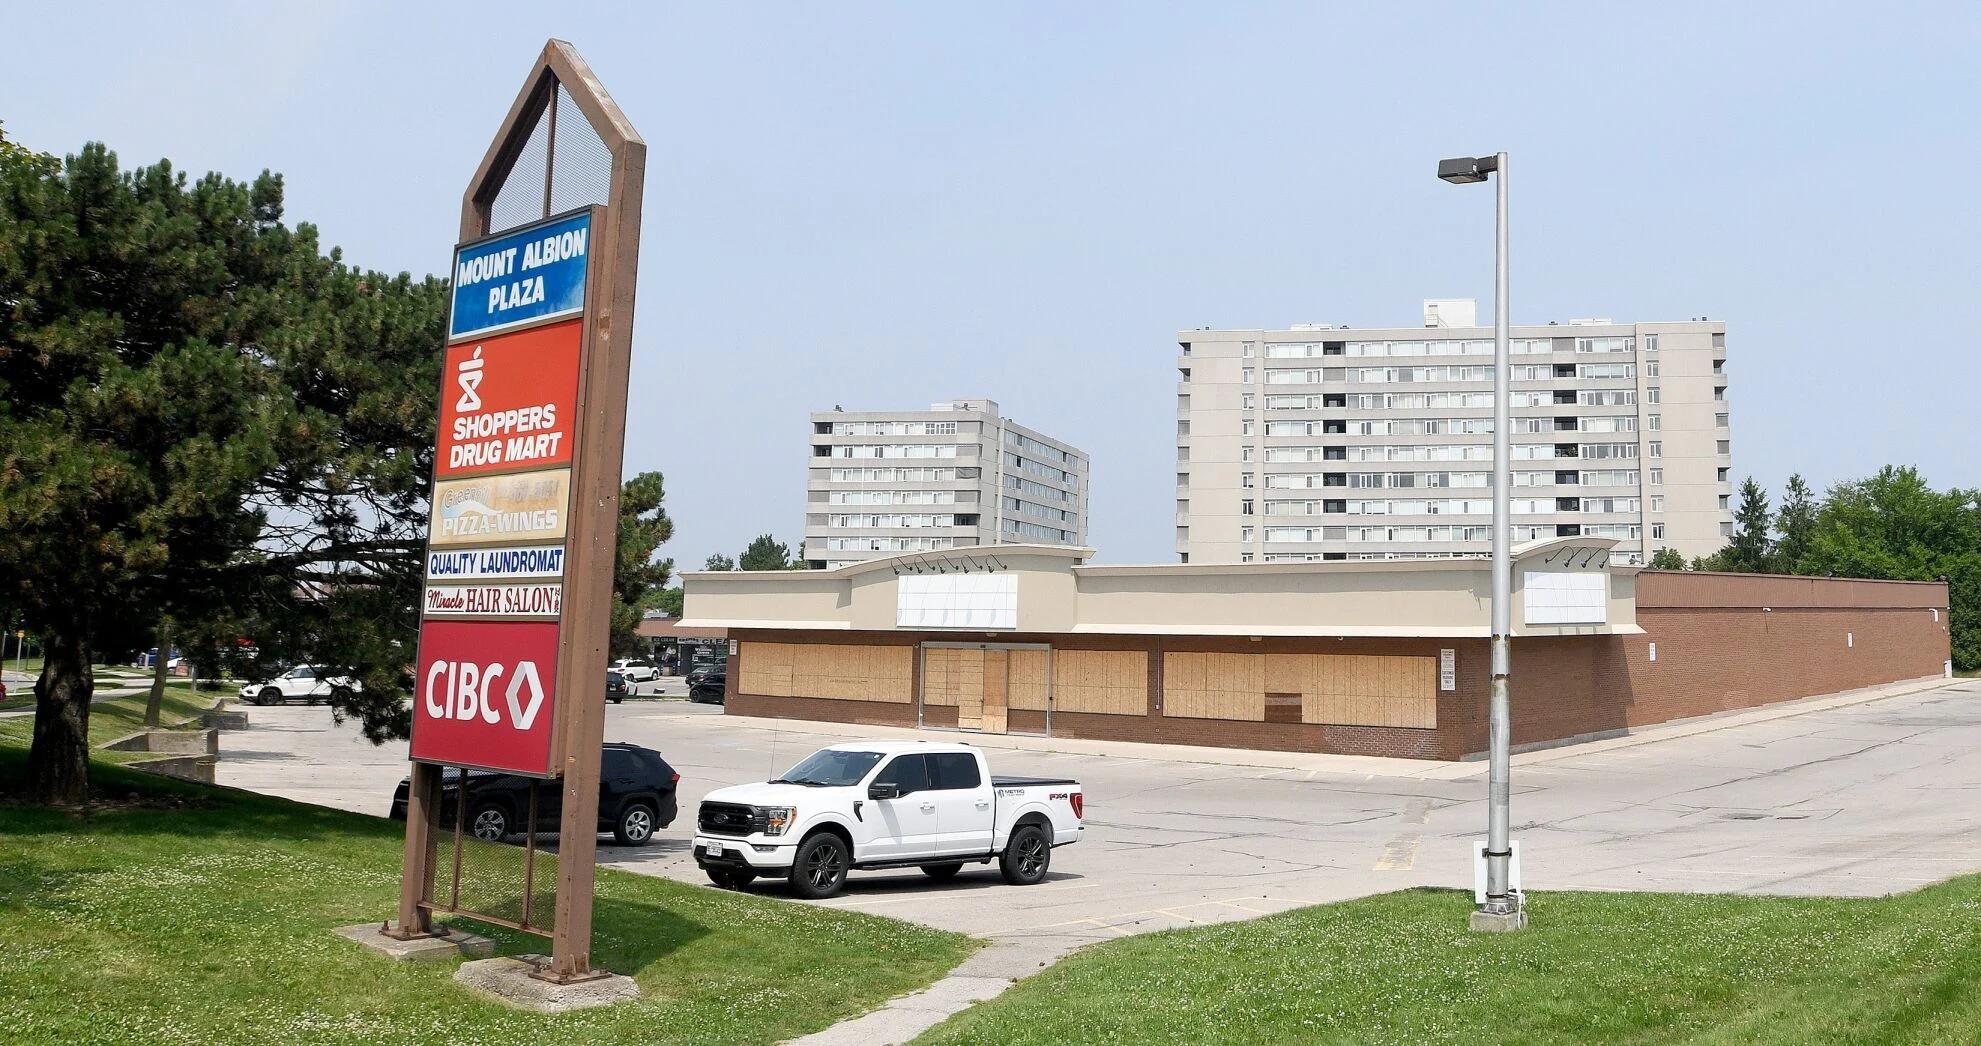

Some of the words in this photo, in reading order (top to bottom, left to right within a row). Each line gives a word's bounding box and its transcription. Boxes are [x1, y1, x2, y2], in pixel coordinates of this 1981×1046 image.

[458, 247, 517, 288] MOUNT
[521, 227, 587, 272] ALBION
[488, 275, 545, 314] PLAZA
[452, 403, 556, 441] SHOPPERS
[449, 438, 502, 469] DRUG
[505, 431, 562, 462] MART
[441, 509, 558, 537] PIZZA-WINGS
[430, 552, 478, 575] QUALITY
[480, 549, 563, 574] LAUNDROMAT
[427, 589, 464, 609] Miracle
[465, 588, 501, 613] HAIR
[504, 587, 554, 613] SALON
[426, 659, 504, 725] CIBC
[1049, 793, 1068, 801] FX4
